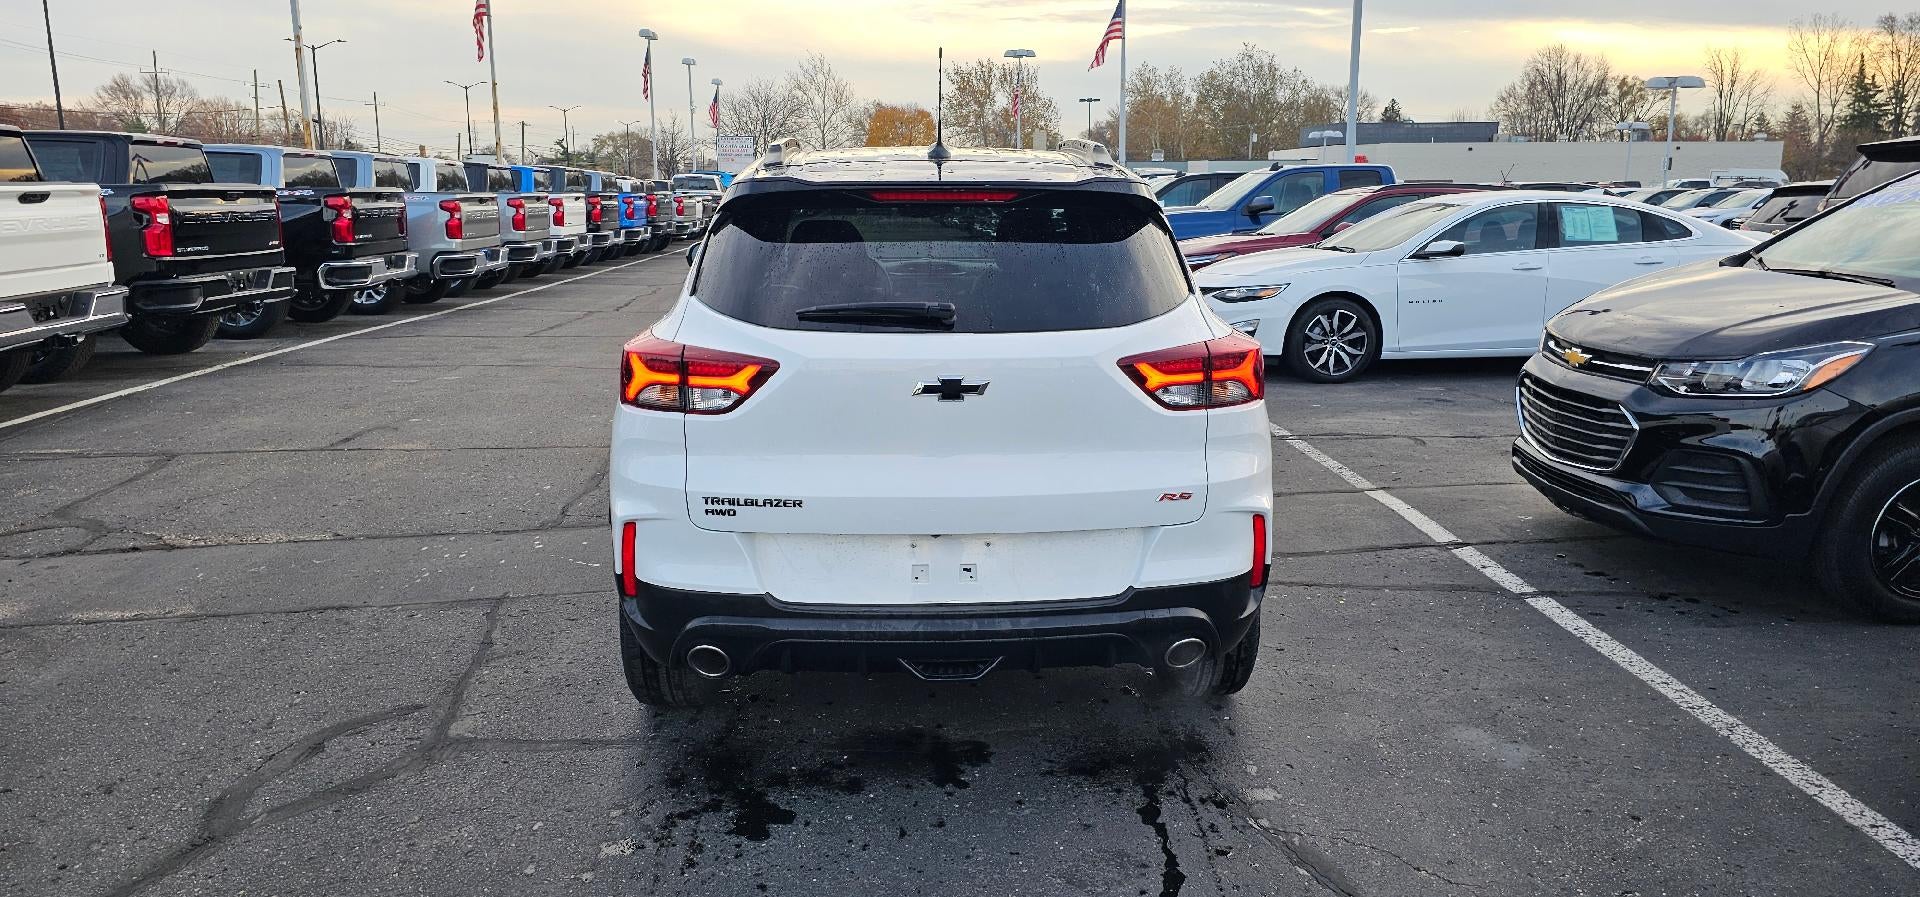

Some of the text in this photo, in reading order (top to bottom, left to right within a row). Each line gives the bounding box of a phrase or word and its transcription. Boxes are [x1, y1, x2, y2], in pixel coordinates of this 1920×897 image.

[701, 496, 803, 508] TRAILBLAZER
[1156, 492, 1193, 502] RS
[704, 508, 737, 517] AWD
